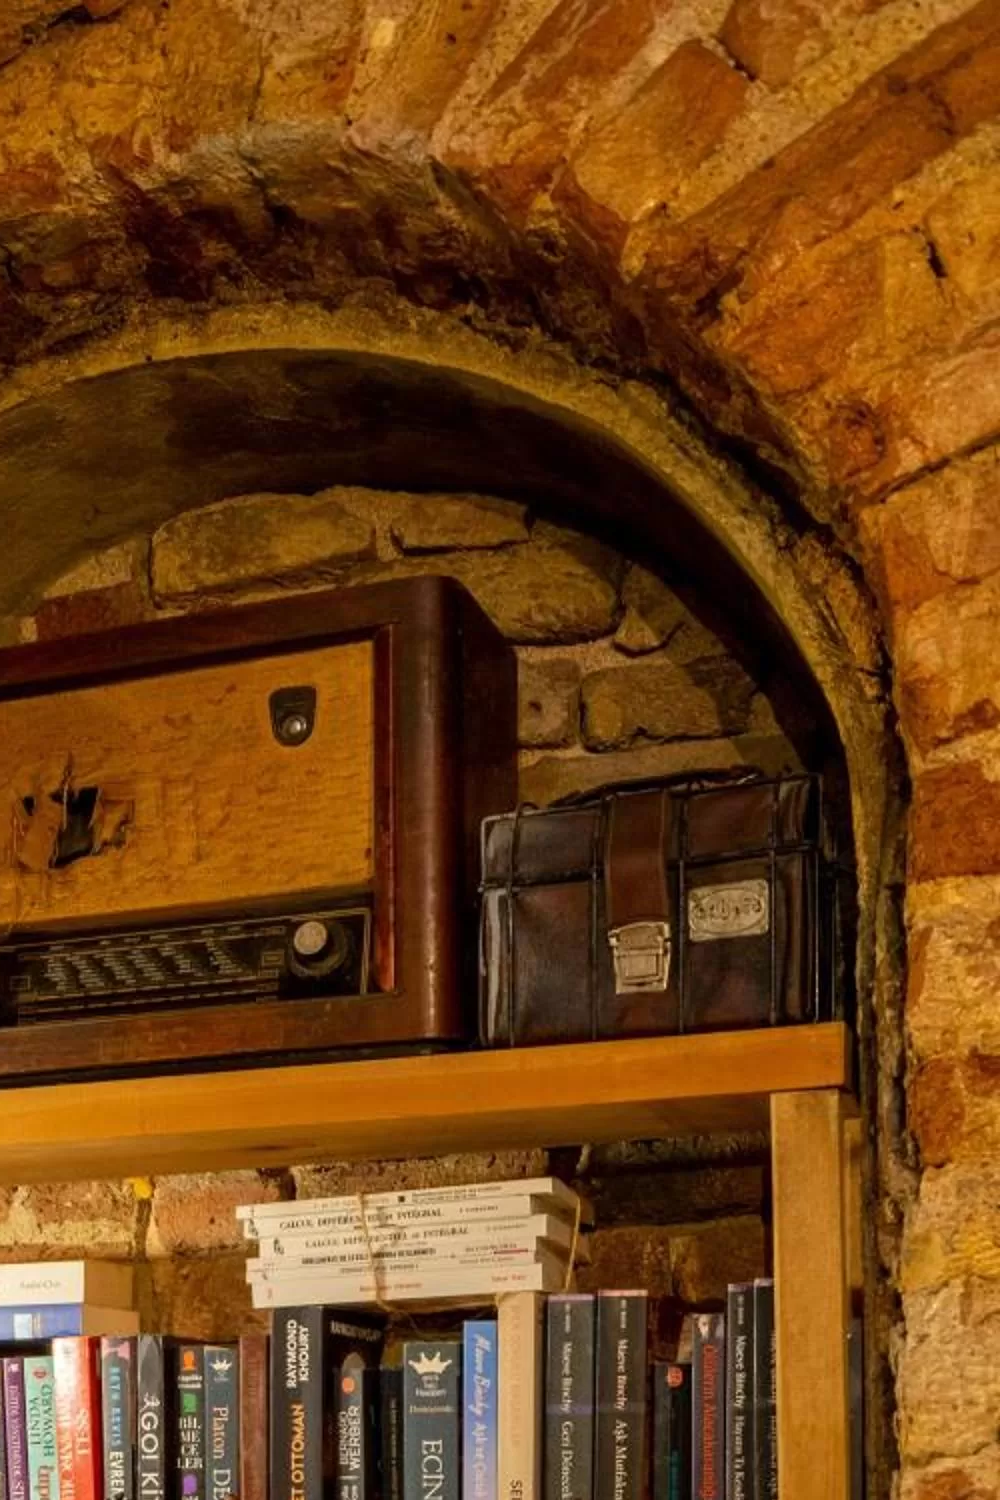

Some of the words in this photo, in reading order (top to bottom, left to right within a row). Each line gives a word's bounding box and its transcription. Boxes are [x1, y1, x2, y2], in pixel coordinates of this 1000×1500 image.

[286, 1318, 298, 1389] RAYMOND
[298, 1325, 309, 1381] KHOURY
[29, 1397, 41, 1445] LINDA
[41, 1384, 55, 1457] HOWARD
[212, 1405, 230, 1459] Platon
[291, 1404, 305, 1484] OTTOMAN
[349, 1405, 360, 1471] WERBER
